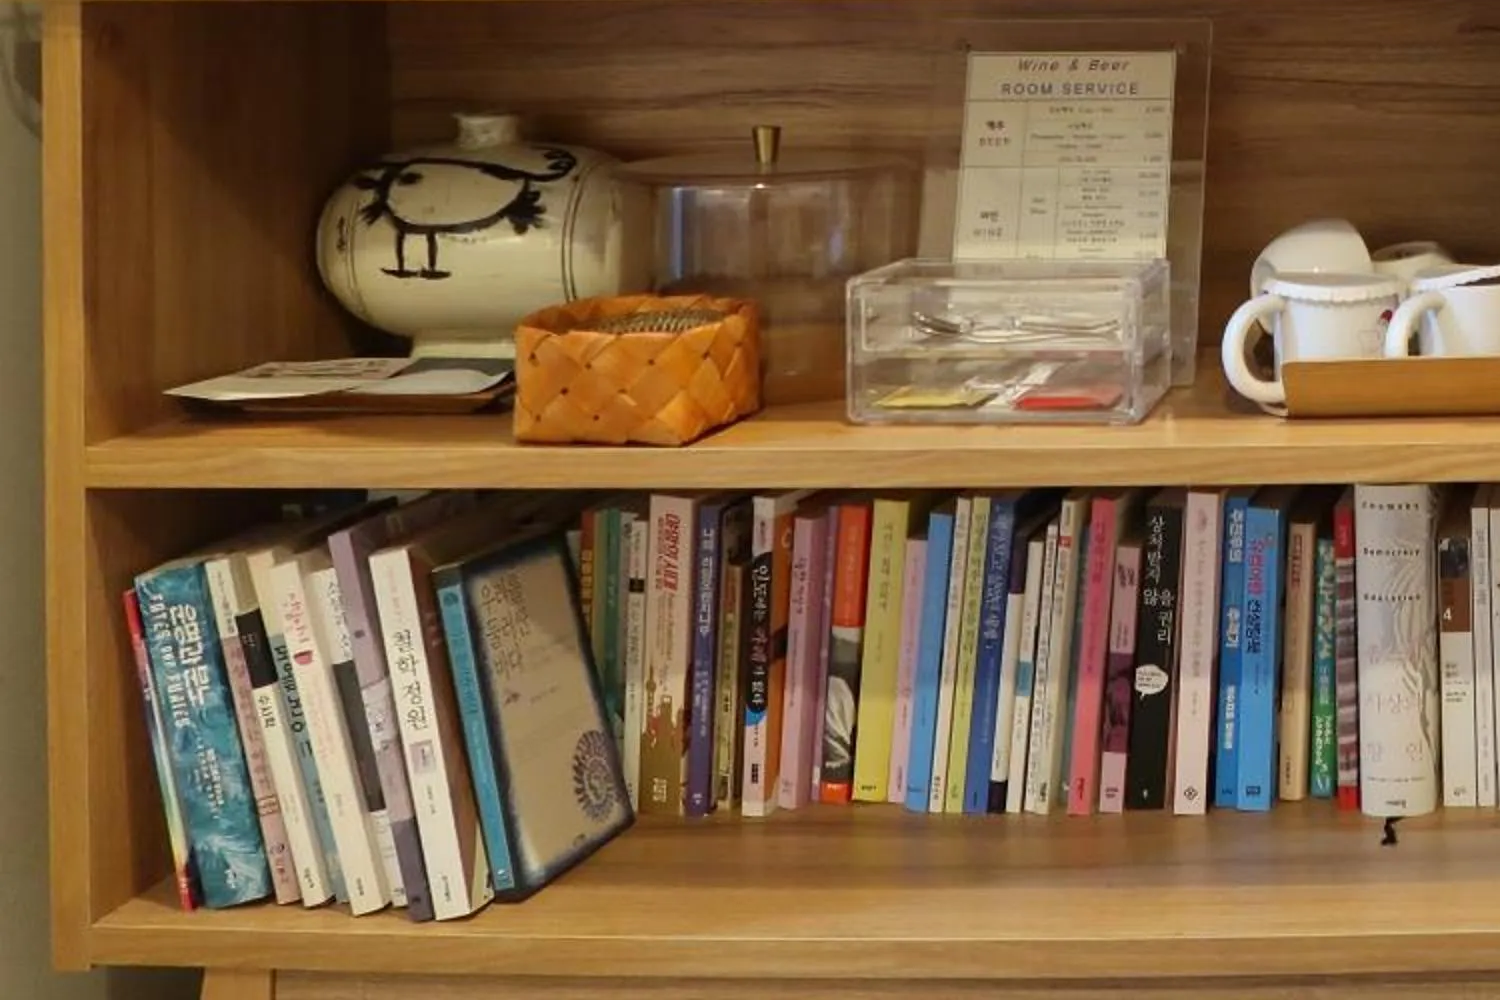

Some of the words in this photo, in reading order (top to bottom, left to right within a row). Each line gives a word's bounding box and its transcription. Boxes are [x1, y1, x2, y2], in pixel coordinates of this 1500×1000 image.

[1018, 58, 1060, 72] Wine
[1088, 58, 1131, 72] Beer
[1001, 82, 1053, 96] ROOM
[1062, 81, 1139, 96] SERVICE
[1443, 607, 1452, 621] 4
